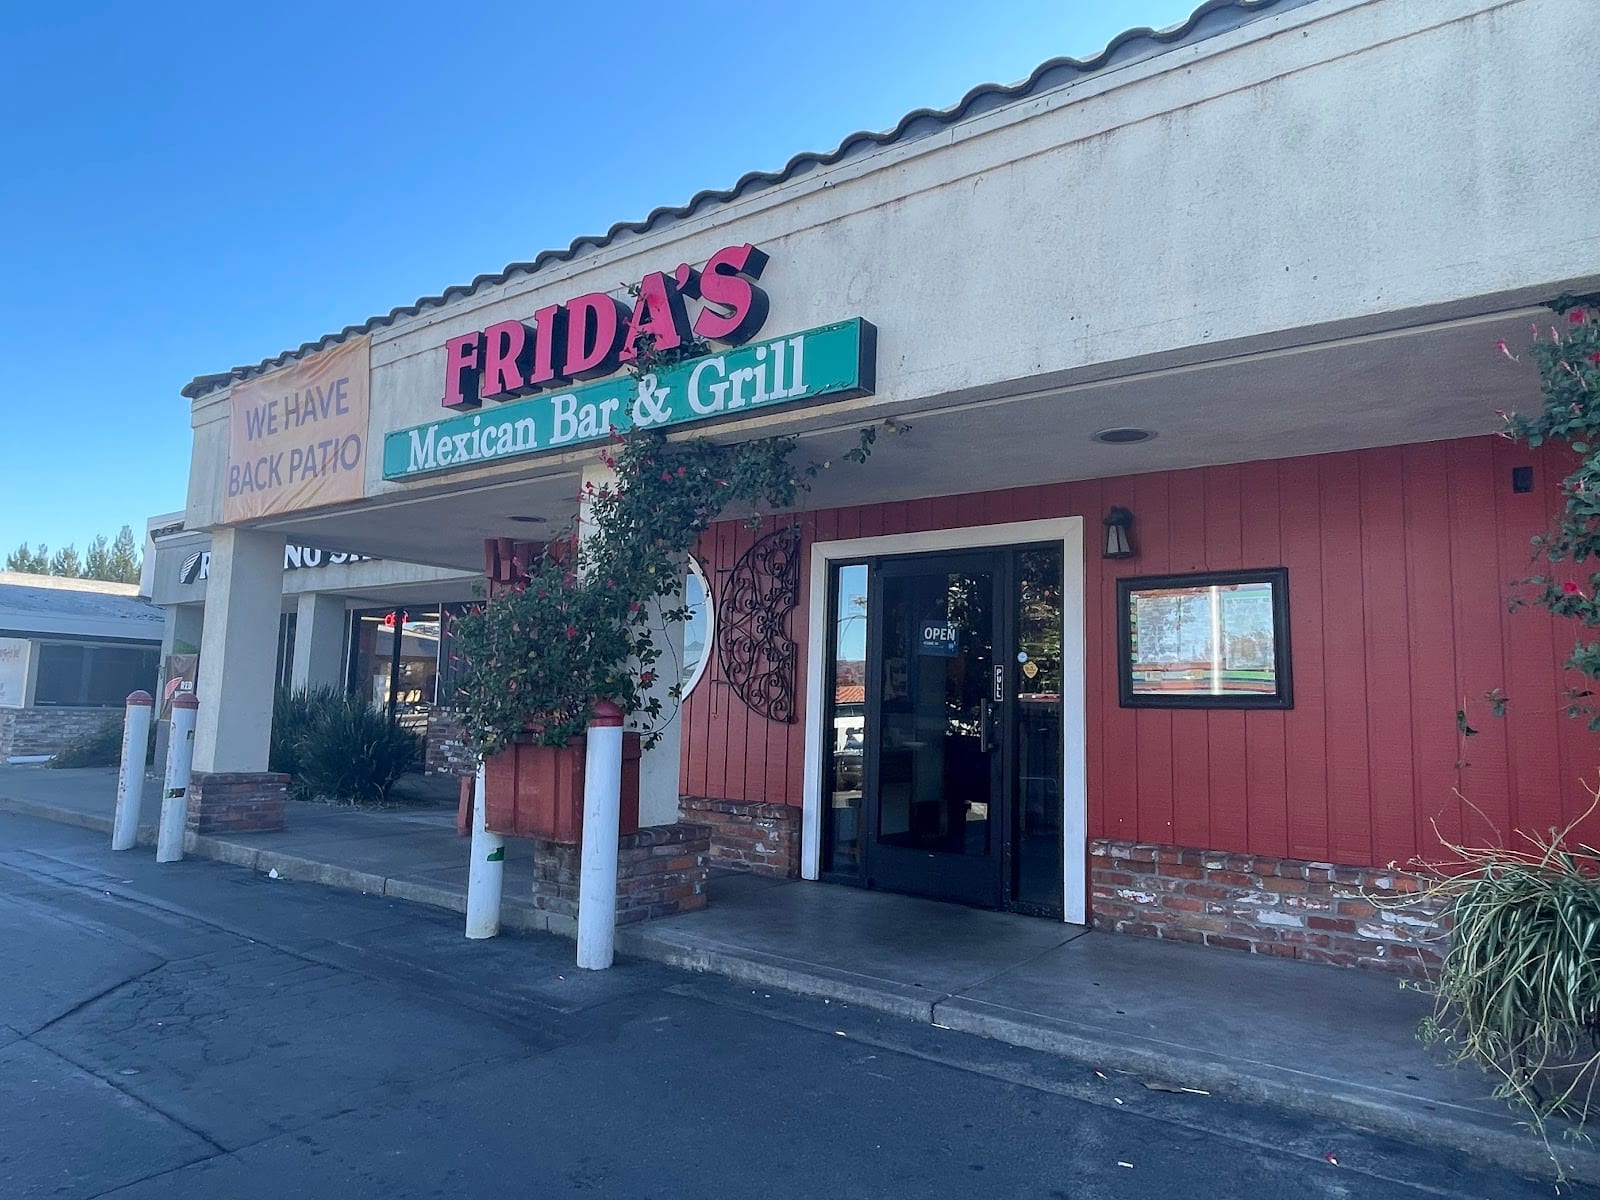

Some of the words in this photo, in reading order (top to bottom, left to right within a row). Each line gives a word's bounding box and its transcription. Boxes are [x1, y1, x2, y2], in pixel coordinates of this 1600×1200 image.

[441, 242, 754, 408] FRIDA'S
[245, 400, 278, 441] WE
[284, 377, 349, 431] HAVE
[407, 415, 538, 472] Mexican
[549, 393, 619, 444] Bar
[632, 373, 673, 427] &
[687, 335, 808, 415] Grill
[228, 452, 284, 497] BACK
[289, 433, 361, 483] PATIO
[924, 626, 956, 641] OPEN
